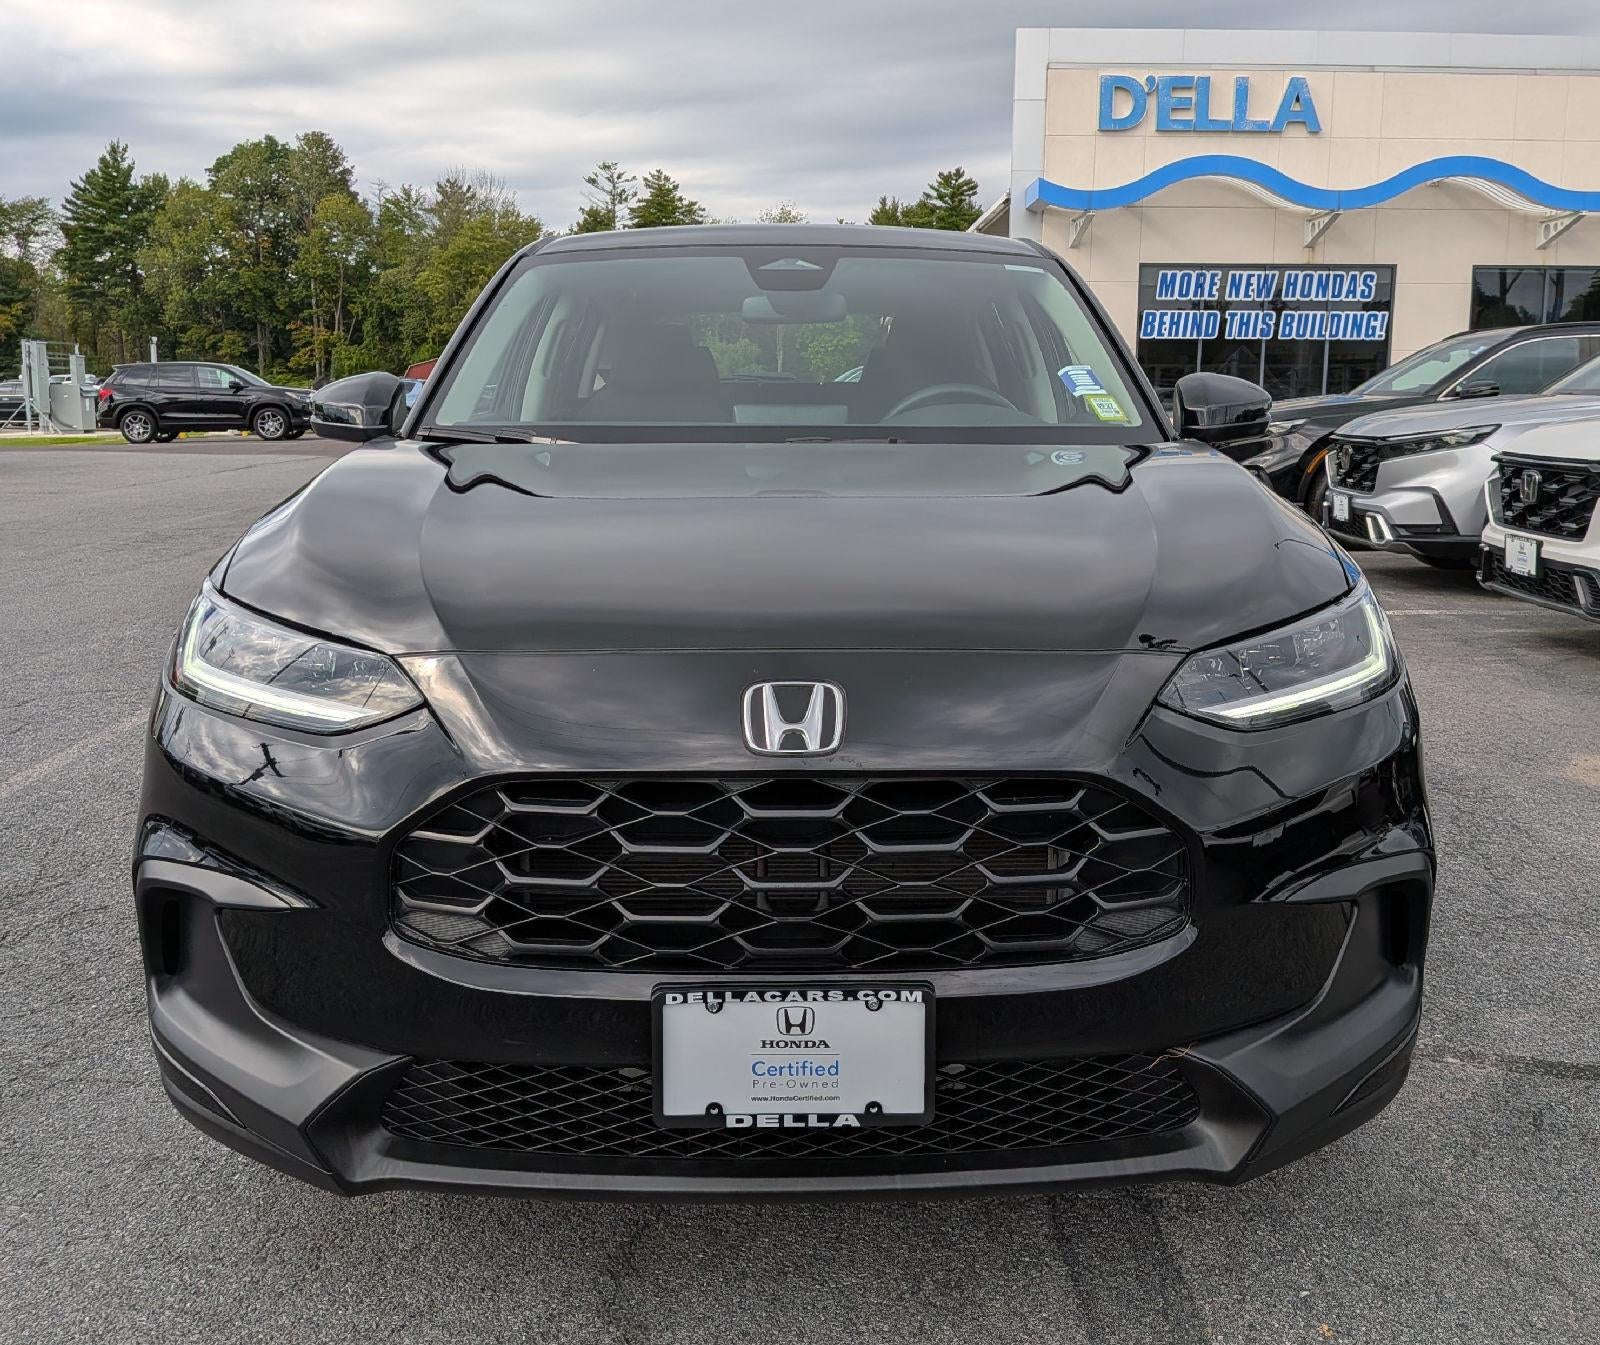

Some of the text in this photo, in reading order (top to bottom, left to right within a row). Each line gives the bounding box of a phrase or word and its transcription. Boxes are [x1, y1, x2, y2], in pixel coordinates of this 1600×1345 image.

[1097, 75, 1322, 132] D'ELLA
[1156, 270, 1377, 301] MORE NEW HONDAS
[1141, 310, 1389, 341] BEHIND THIS BUILDING!
[665, 990, 923, 1005] DELLACARS.COM
[760, 1039, 831, 1049] HONDA
[751, 1060, 840, 1077] Certified
[752, 1078, 840, 1089] Pre-Owned
[750, 1094, 841, 1102] www.HondaCertified.com
[725, 1113, 861, 1128] DELLA
